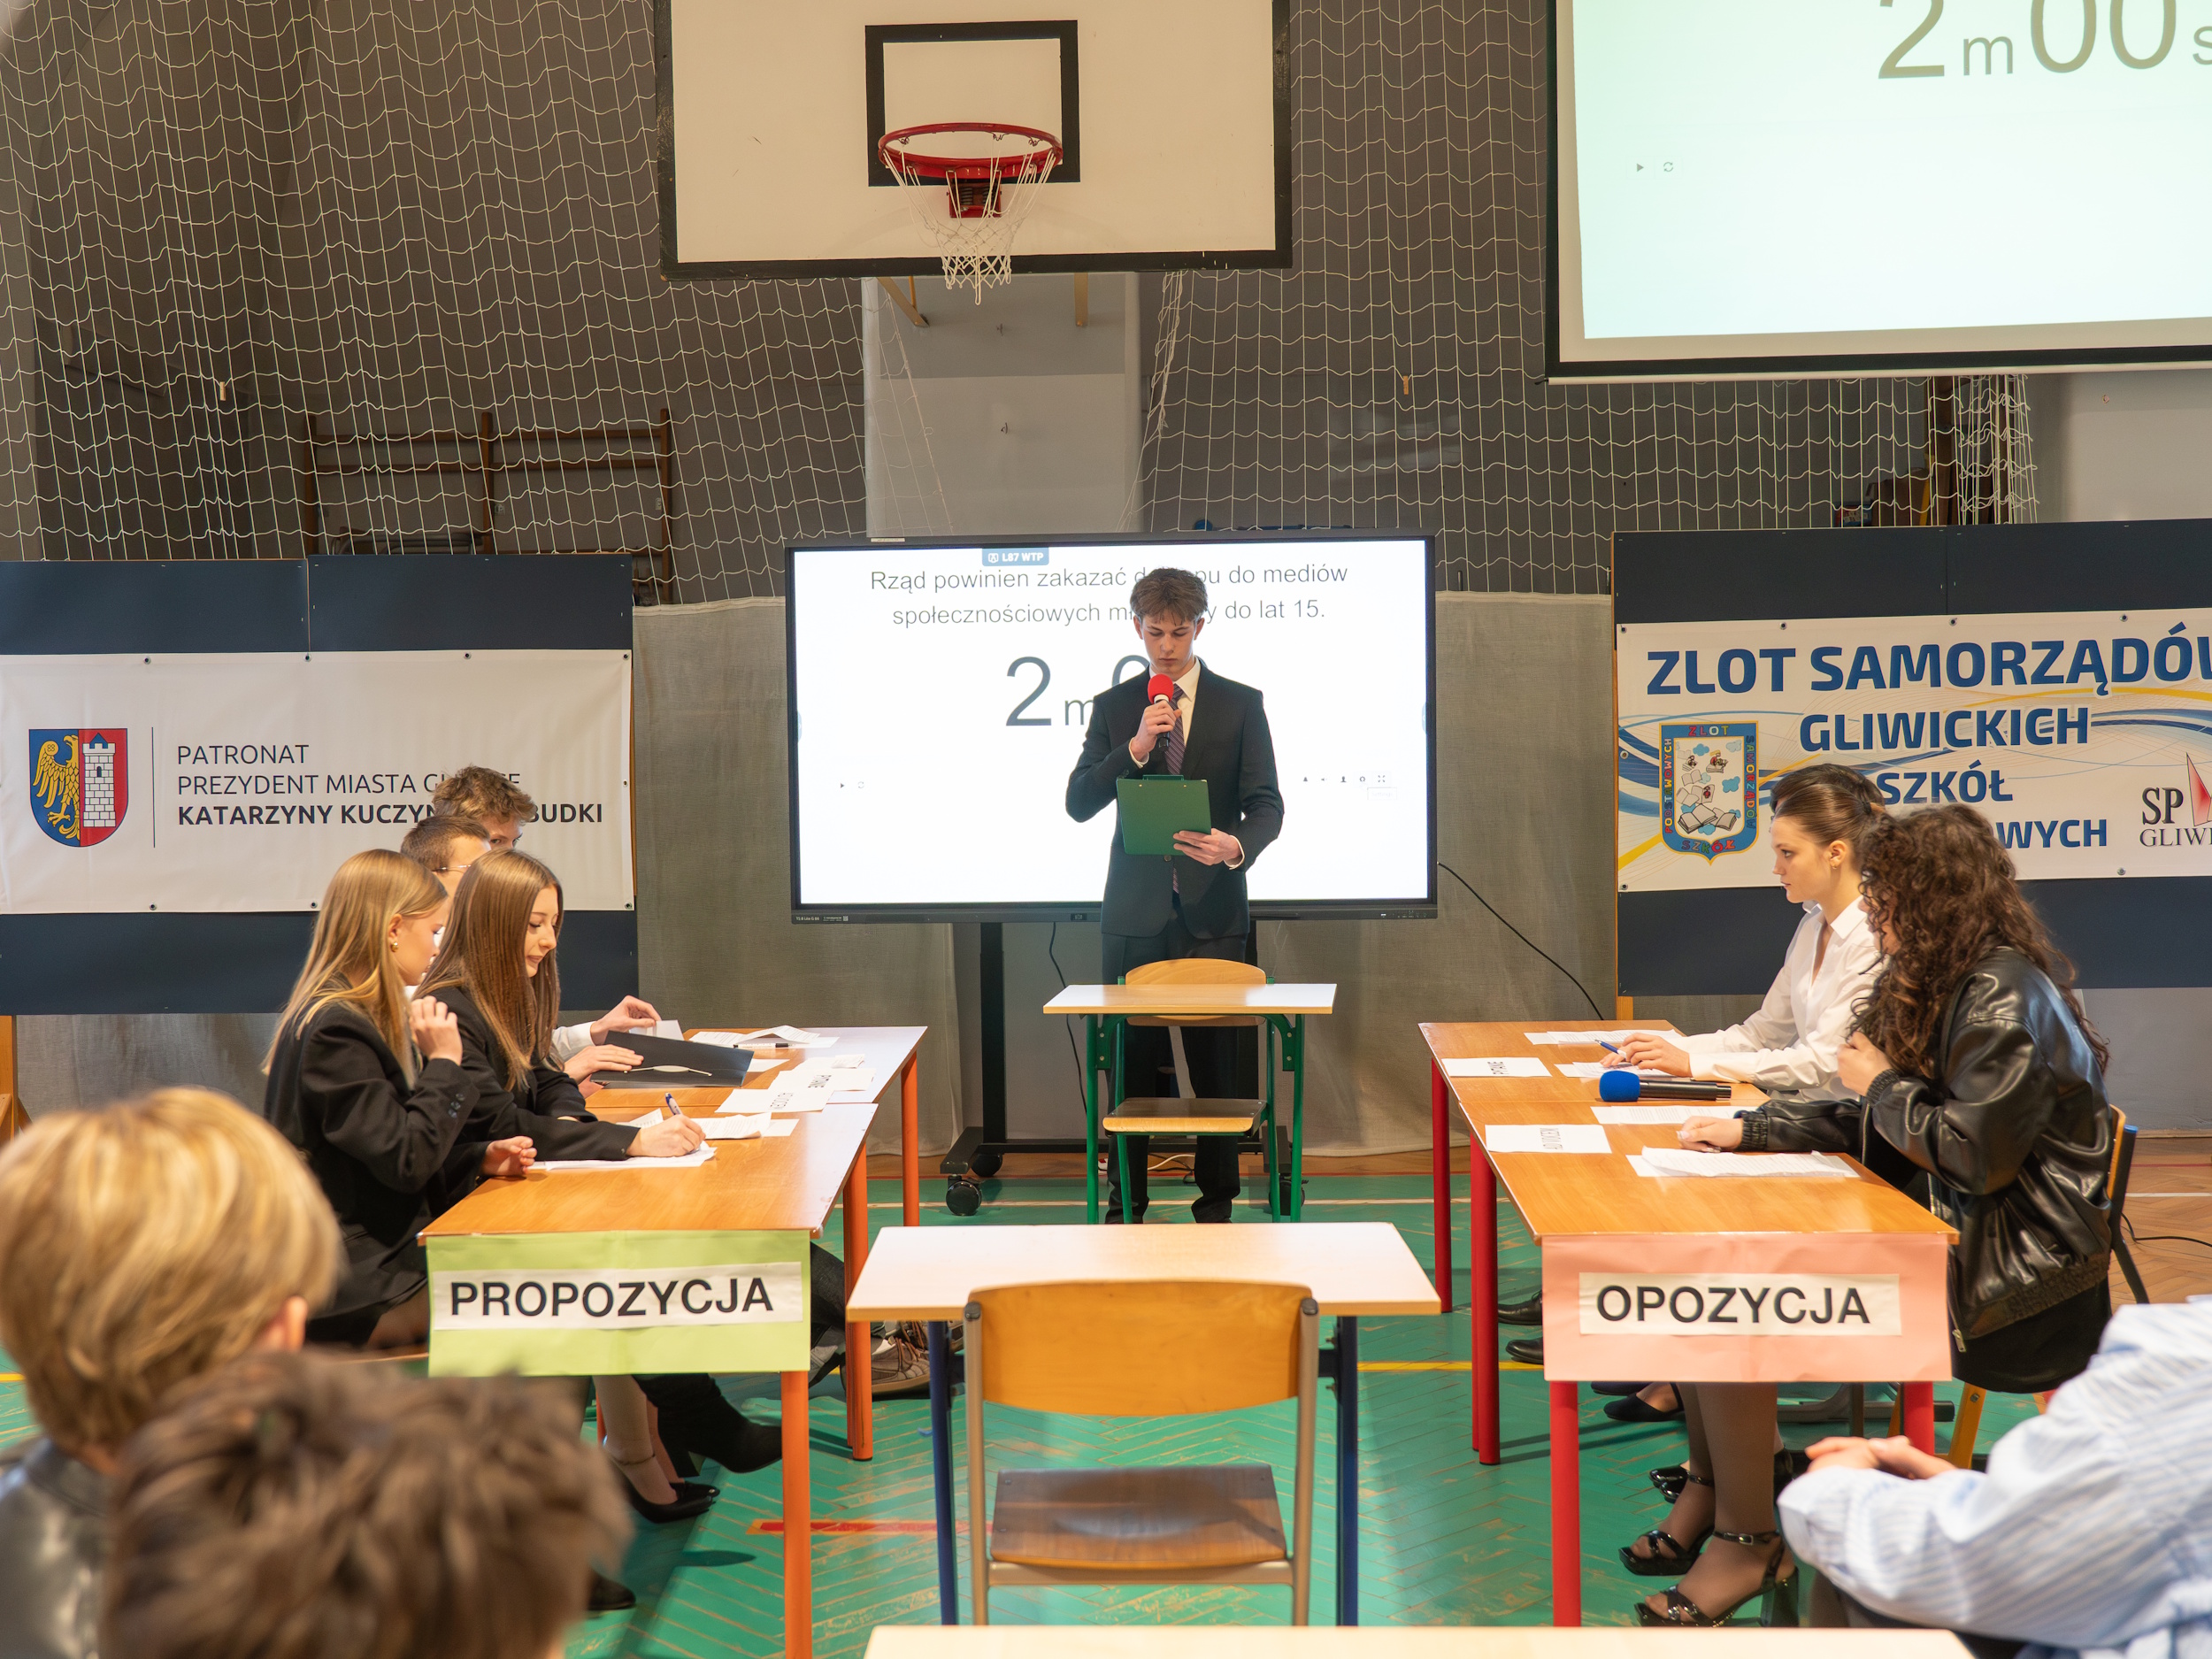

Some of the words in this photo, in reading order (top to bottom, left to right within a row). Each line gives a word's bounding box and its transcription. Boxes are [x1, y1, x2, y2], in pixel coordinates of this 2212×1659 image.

[1002, 553, 1018, 563] L87
[1021, 552, 1044, 562] WTP
[872, 571, 926, 594] Rząd
[934, 569, 1029, 593] powinien
[1037, 567, 1126, 587] zakazać
[1229, 565, 1255, 584] do
[1263, 564, 1348, 583] mediów
[893, 603, 1100, 628] społecznościowych
[1225, 601, 1251, 618] do
[1260, 600, 1285, 618] lat
[1294, 599, 1325, 618] 15.
[1647, 649, 1796, 695] ZLOT
[1810, 622, 2212, 696] SAMORZĄDÓ
[1688, 726, 1730, 736] ZLOT
[1800, 708, 2088, 752] GLIWICKICH
[178, 744, 310, 764] PATRONAT
[179, 774, 319, 795] PREZYDENT
[326, 773, 417, 794] MIASTA
[1663, 738, 1673, 833] PODSTAWOWYCH
[1745, 735, 1757, 829] SAMORZĄDÓW
[1877, 759, 2013, 805] SZKÓŁ
[179, 804, 334, 825] KATARZYNY
[2142, 787, 2184, 825] SP
[1681, 840, 1736, 854] SZKÓŁ
[451, 1277, 774, 1317] PROPOZYCJA
[1596, 1285, 1870, 1324] OPOZYCJA
